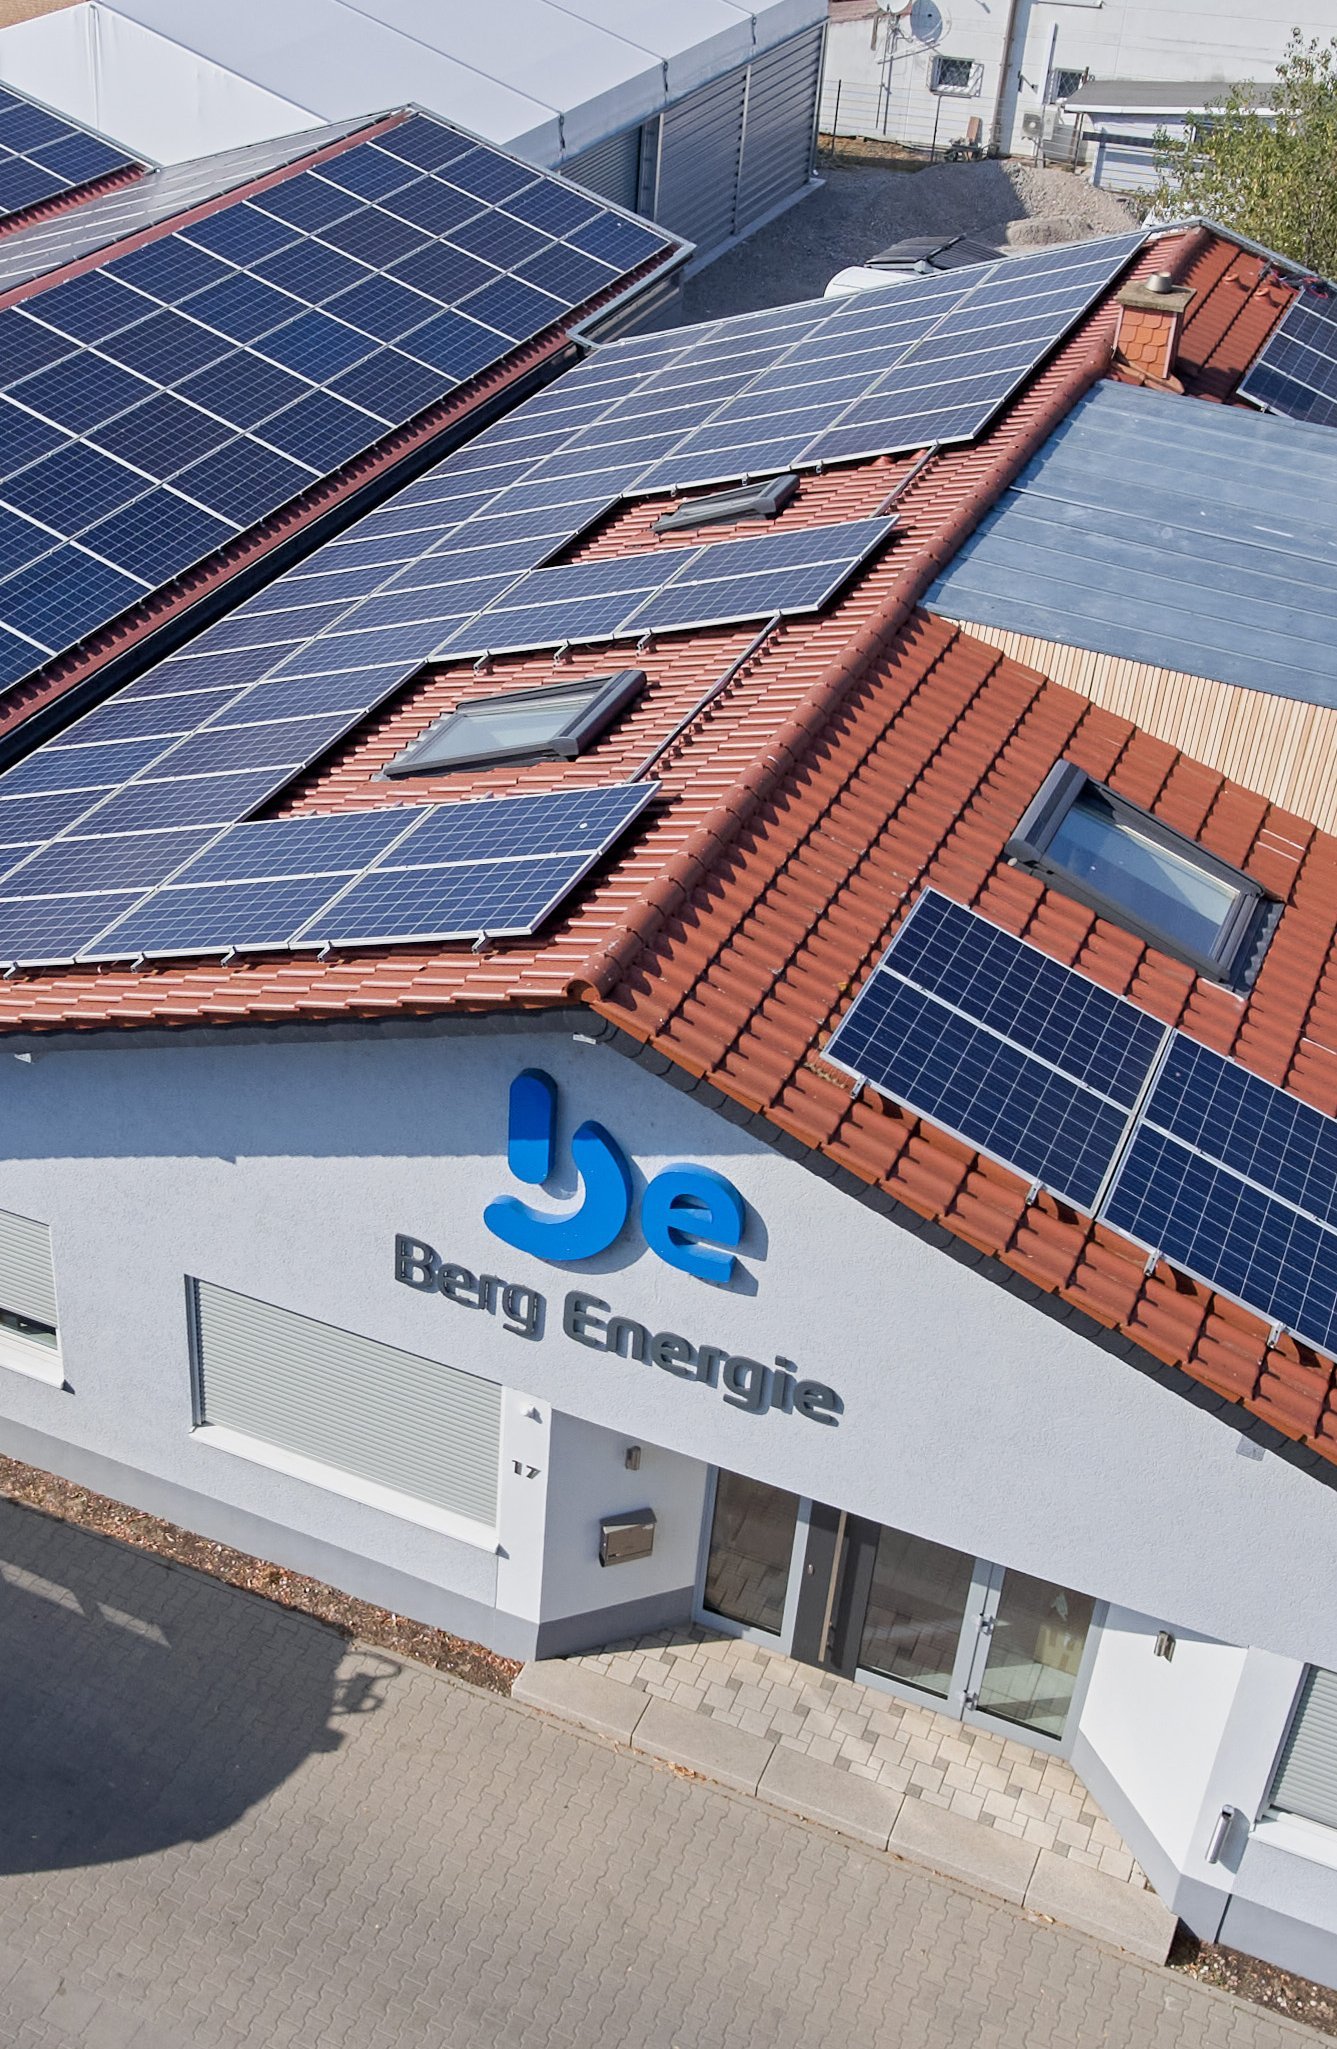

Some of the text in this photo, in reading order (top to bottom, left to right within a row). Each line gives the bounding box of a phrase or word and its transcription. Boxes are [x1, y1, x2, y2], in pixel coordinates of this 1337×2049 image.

[394, 1233, 843, 1427] Berg Energie
[511, 1459, 542, 1480] 17
